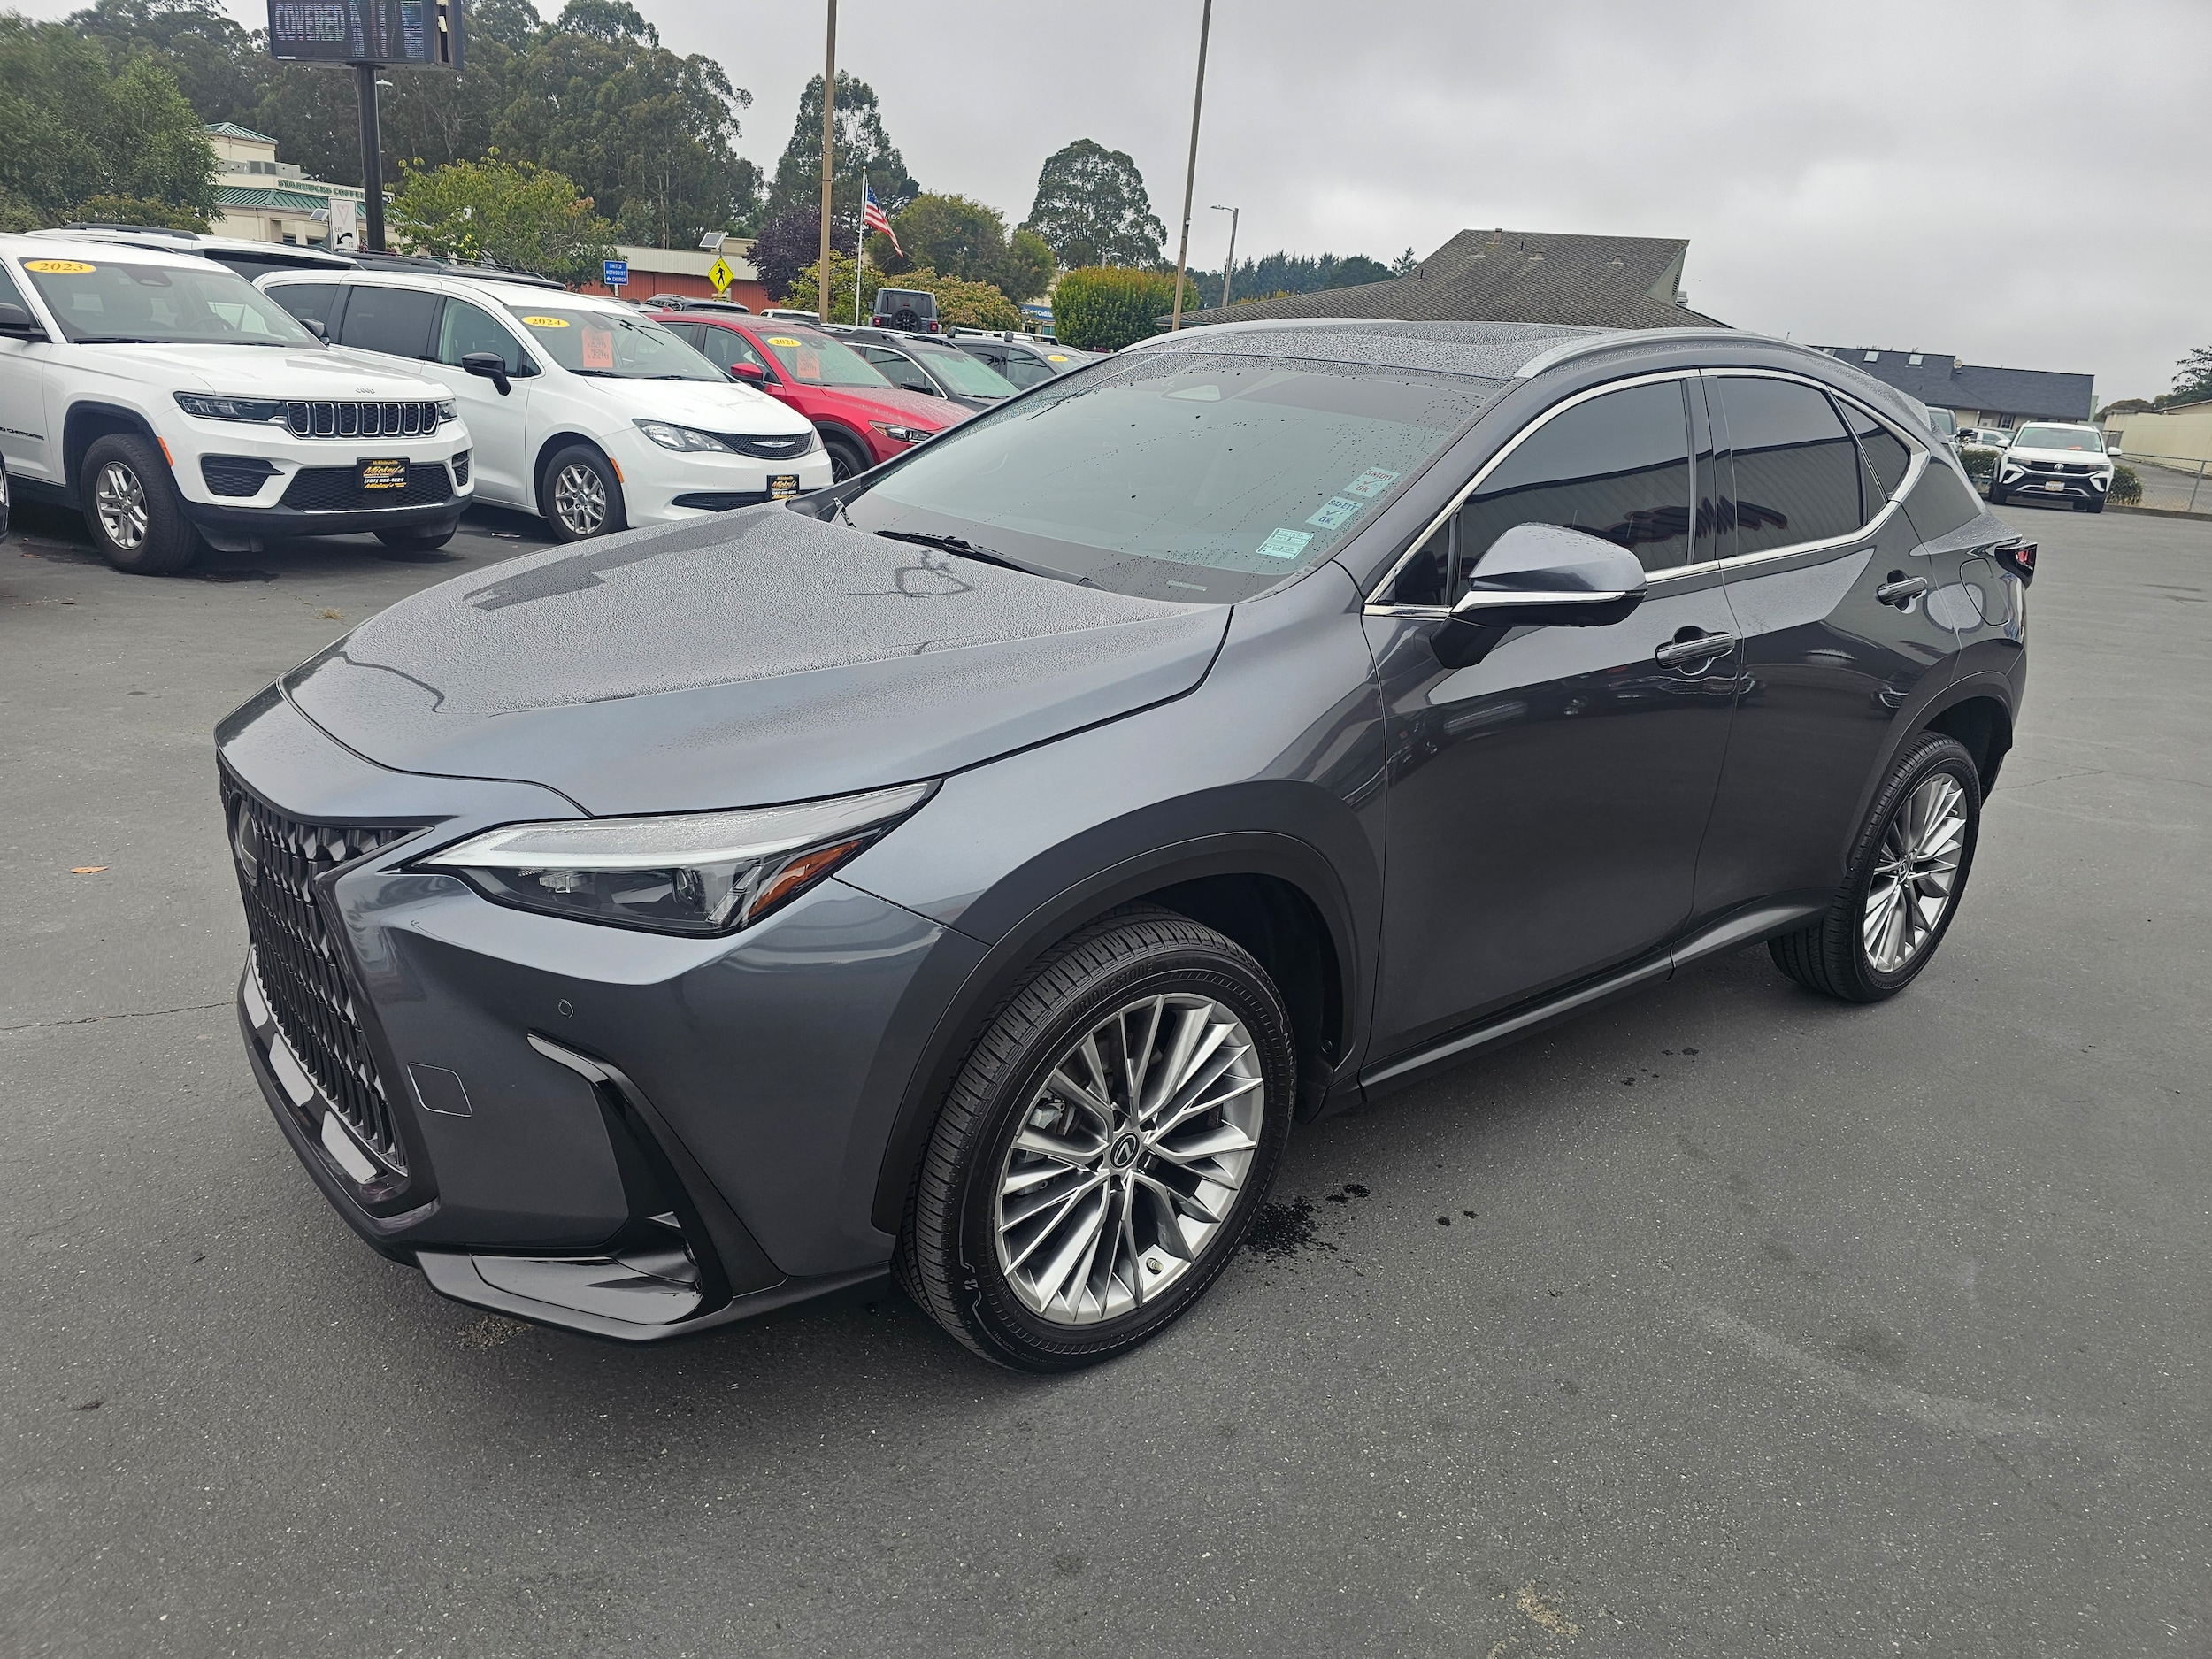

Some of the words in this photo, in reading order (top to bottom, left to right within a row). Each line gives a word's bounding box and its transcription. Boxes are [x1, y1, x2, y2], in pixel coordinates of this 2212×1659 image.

[275, 4, 345, 41] COVERED
[278, 179, 333, 195] STARBUCKS
[39, 262, 83, 271] 2023
[1364, 470, 1393, 480] SMOG
[1328, 499, 1357, 511] SAFETY
[1067, 962, 1153, 1019] BRIDGESTONE
